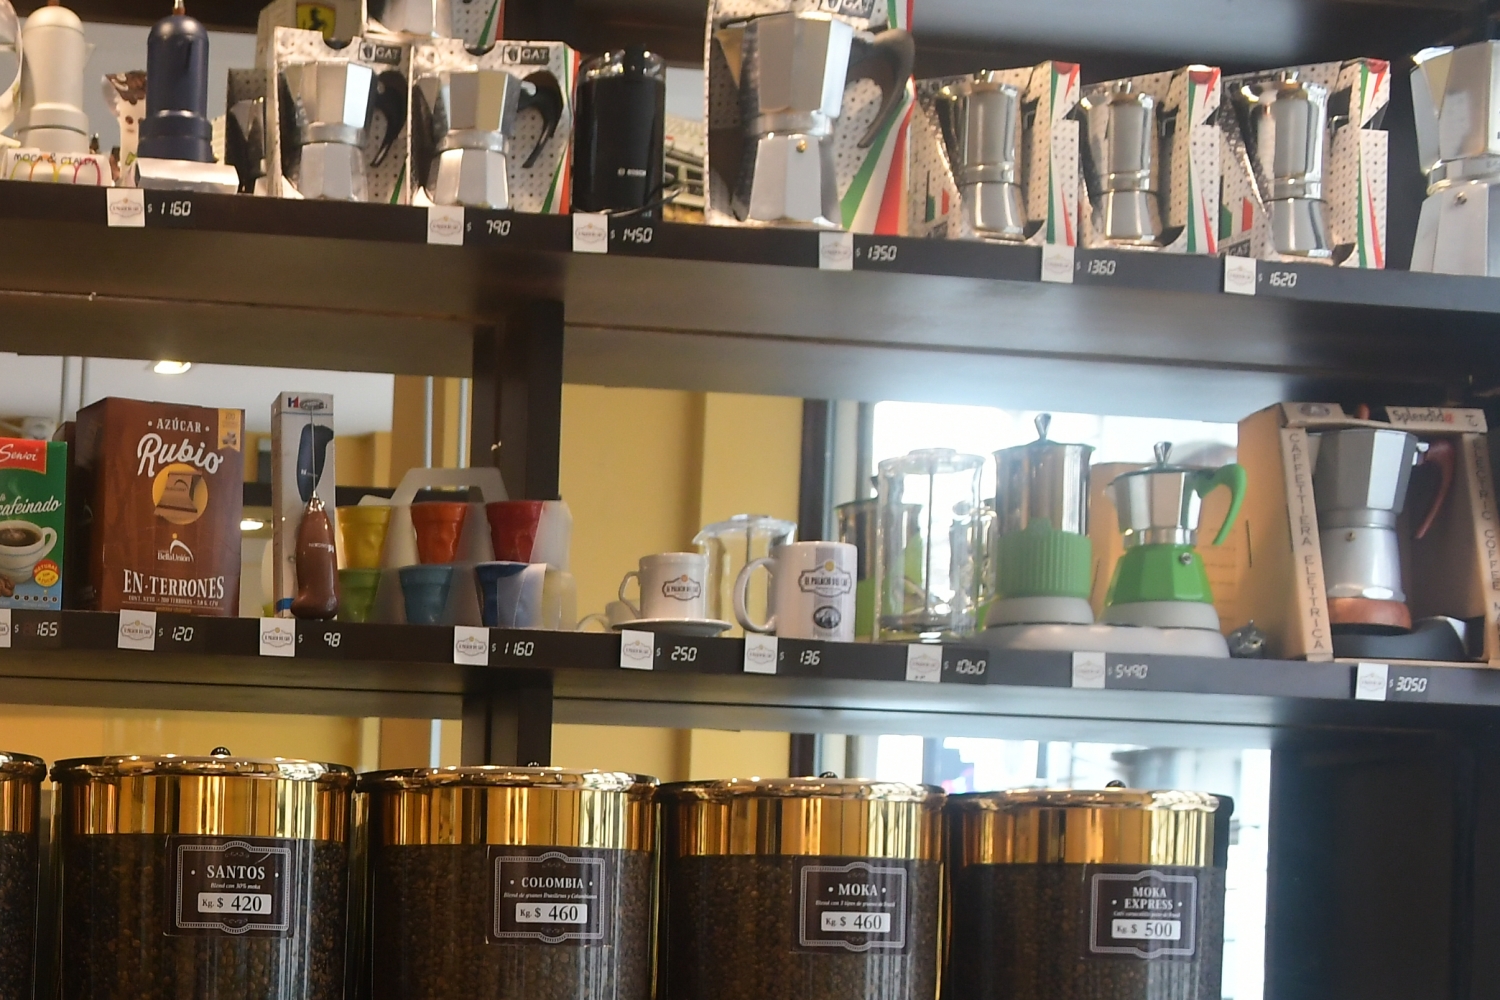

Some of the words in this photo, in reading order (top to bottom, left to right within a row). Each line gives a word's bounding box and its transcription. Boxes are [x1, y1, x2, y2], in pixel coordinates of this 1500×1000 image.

[376, 47, 400, 63] GAT
[522, 47, 548, 61] GAT
[13, 152, 43, 163] MOCA
[160, 201, 191, 217] 1160
[485, 220, 511, 236] 790
[622, 226, 653, 244] 1450
[867, 245, 898, 262] 1350
[1087, 260, 1117, 276] 1360
[1269, 272, 1298, 289] 1620
[1393, 407, 1454, 425] Splendida
[156, 417, 202, 433] AZÚCAR
[136, 432, 224, 478] Rubio
[123, 568, 144, 594] EN
[148, 575, 226, 600] TERRONES
[1304, 554, 1325, 650] ELETTRICA
[36, 621, 58, 637] 165
[171, 626, 194, 642] 120
[323, 632, 341, 647] 98
[503, 641, 535, 657] 1160
[671, 645, 698, 662] 250
[800, 650, 821, 666] 136
[1116, 664, 1148, 679] 5490
[1396, 676, 1428, 693] 3050
[206, 864, 266, 880] SANTOS
[521, 876, 584, 889] COLOMBIA
[838, 884, 878, 896] MOKA
[1132, 886, 1167, 898] MOKA
[202, 899, 214, 908] Kg.
[217, 898, 224, 908] $
[231, 895, 262, 911] 420
[1124, 898, 1174, 910] EXPRESS
[534, 907, 541, 918] $
[548, 905, 579, 921] 460
[840, 916, 846, 927] $
[853, 914, 882, 930] 460
[1131, 923, 1138, 934] $
[1144, 922, 1172, 937] 500
